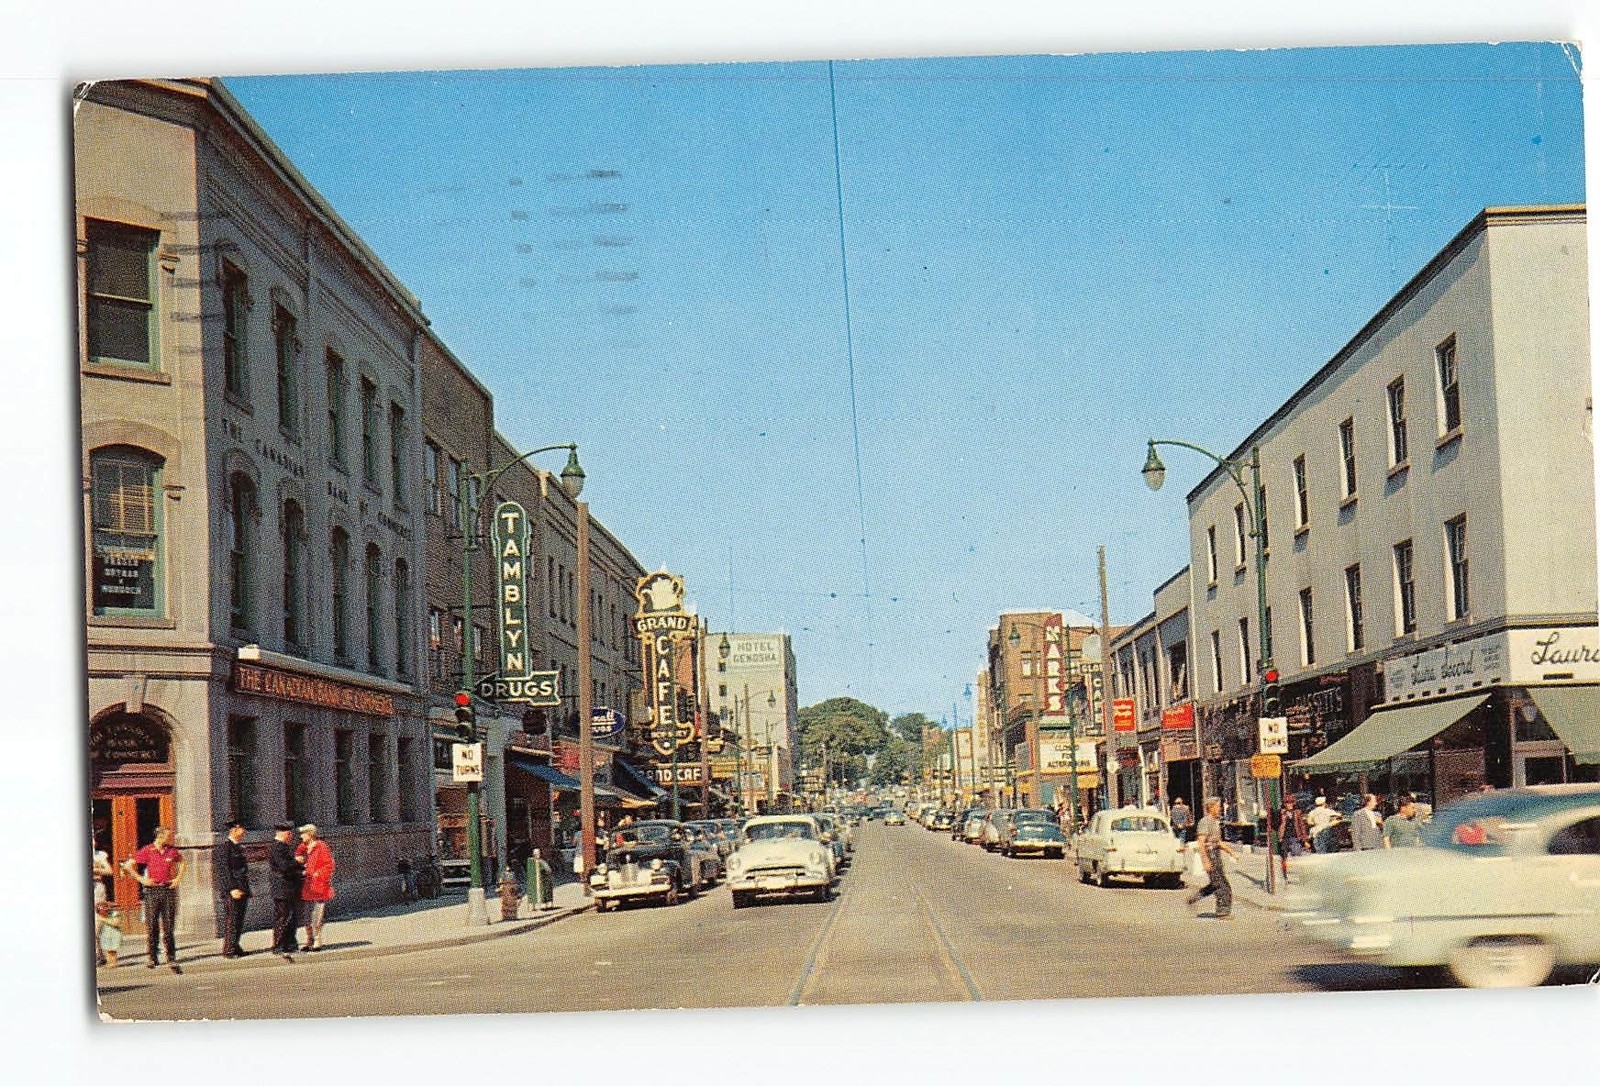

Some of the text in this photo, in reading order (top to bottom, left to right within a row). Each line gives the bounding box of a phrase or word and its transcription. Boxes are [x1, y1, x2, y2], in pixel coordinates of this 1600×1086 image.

[501, 512, 524, 671] TAMBLYN
[637, 616, 687, 633] GRAND
[737, 642, 774, 652] HOTEL
[1045, 625, 1062, 712] MARKS
[239, 666, 261, 691] THE
[264, 673, 315, 701] CANADIAN
[656, 635, 673, 725] CAFE
[480, 681, 553, 698] DRUGS
[1268, 723, 1279, 734] NO
[1263, 736, 1287, 748] TURNS
[461, 749, 474, 760] NO
[456, 764, 480, 776] TURNS
